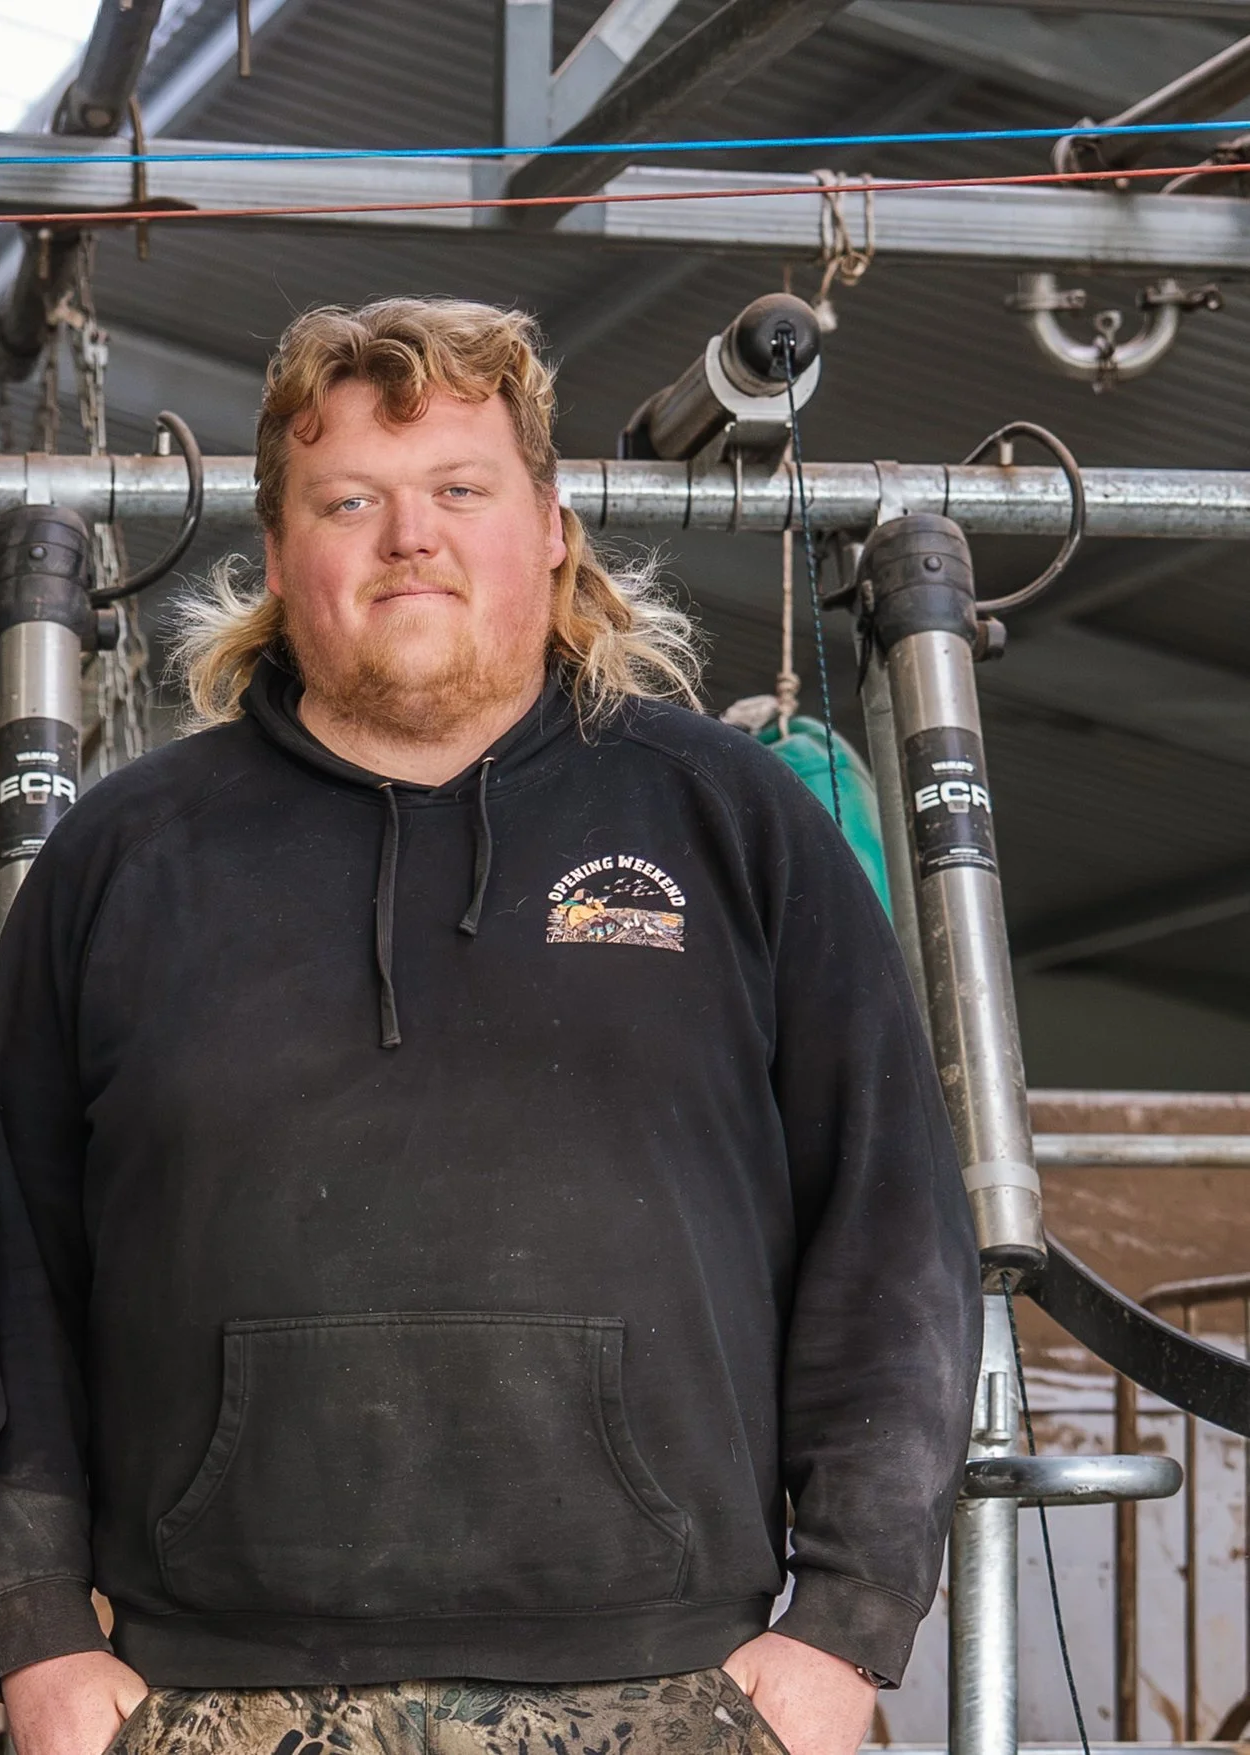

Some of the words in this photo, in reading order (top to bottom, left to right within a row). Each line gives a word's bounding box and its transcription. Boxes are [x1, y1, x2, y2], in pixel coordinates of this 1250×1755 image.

[0, 771, 77, 804] ECR
[915, 781, 992, 813] ECR
[548, 856, 614, 902] OPENING
[618, 855, 686, 907] WEEKEND
